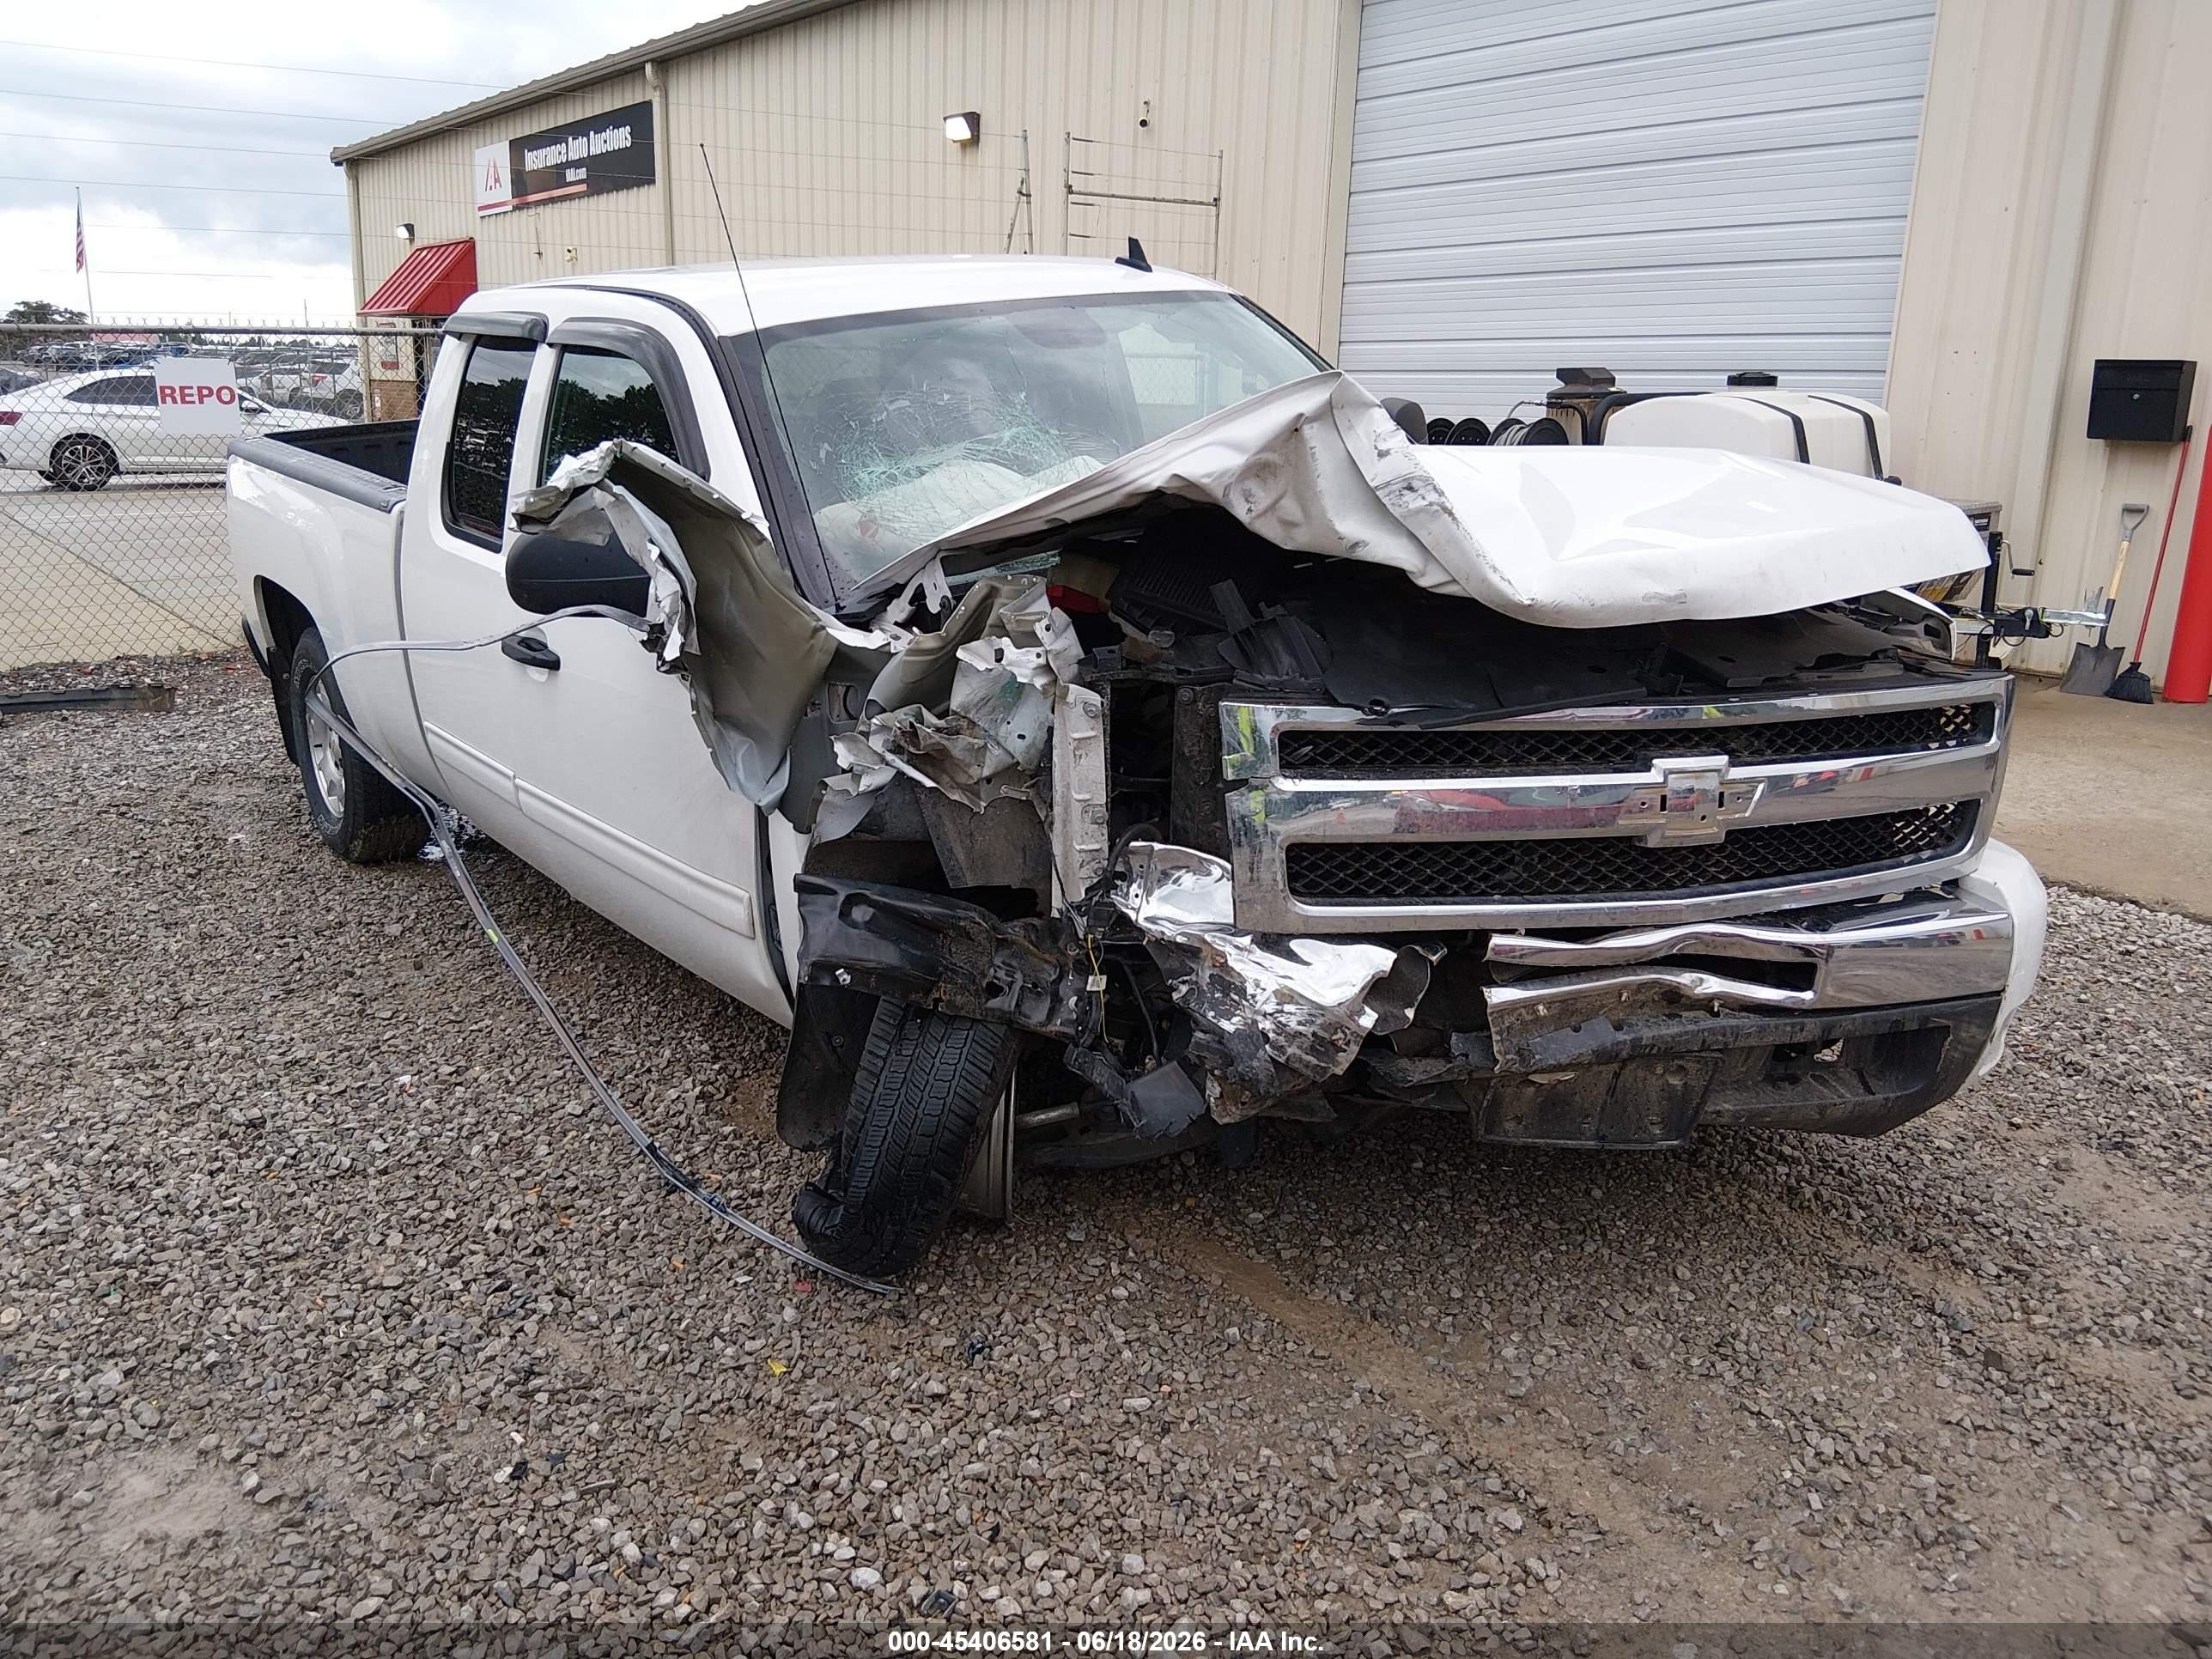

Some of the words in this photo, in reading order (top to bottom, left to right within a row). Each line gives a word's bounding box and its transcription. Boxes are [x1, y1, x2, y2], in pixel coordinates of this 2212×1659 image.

[525, 142, 568, 172] Insurance
[568, 136, 589, 162] Auto
[589, 125, 632, 156] Auctions
[158, 385, 237, 405] REPO
